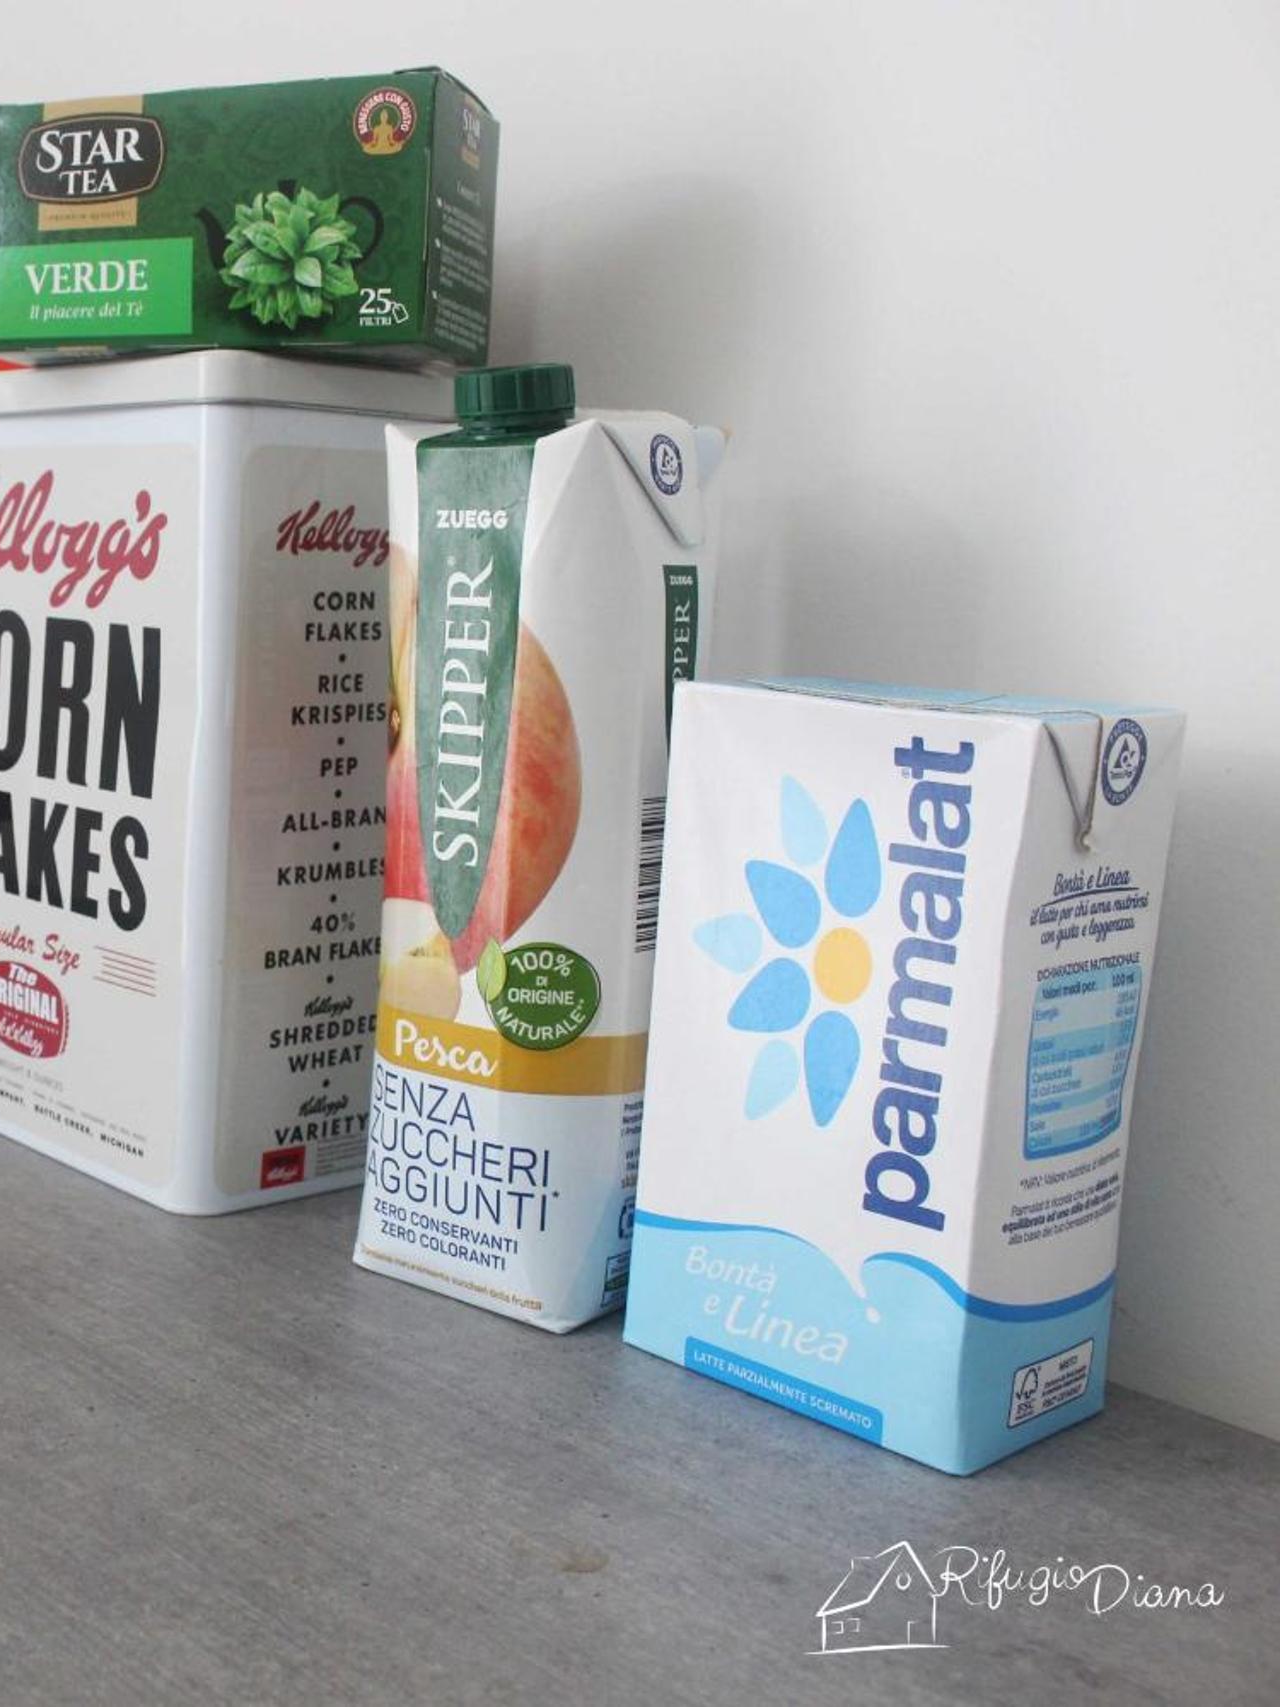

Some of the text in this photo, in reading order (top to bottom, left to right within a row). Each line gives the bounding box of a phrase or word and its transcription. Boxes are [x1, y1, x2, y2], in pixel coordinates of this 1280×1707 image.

[36, 127, 143, 173] STAR
[59, 169, 117, 195] TEA
[25, 259, 149, 295] VERDE
[30, 300, 143, 322] Il piacere del Tè
[359, 288, 392, 315] 25
[359, 316, 391, 326] FILTRI
[436, 508, 510, 530] ZUEGG
[276, 500, 390, 569] Kellogg
[313, 591, 376, 612] CORN
[305, 622, 382, 642] FLAKES
[672, 600, 690, 683] PPER
[319, 674, 364, 694] RICE
[292, 702, 387, 726] KRISPIES
[432, 556, 494, 867] SKIPPER
[320, 757, 359, 778] PEP
[281, 806, 387, 834] ALL-BRAN
[1096, 866, 1130, 888] Linea
[310, 911, 356, 934] 40%
[42, 934, 81, 976] Size
[264, 937, 382, 970] BRAN FLAKE
[511, 951, 574, 977] 100%
[9, 963, 38, 986] The
[535, 976, 548, 987] DI
[862, 736, 976, 1232] parmalat
[507, 987, 575, 1005] ORIGINE
[288, 1045, 363, 1074] WHEAT
[394, 1019, 499, 1078] Pesca
[375, 1063, 475, 1131] SENZA
[274, 1111, 369, 1146] VARIETY
[370, 1105, 550, 1188] ZUCCHERI
[374, 1197, 407, 1222] ZERO
[410, 1211, 518, 1254] CONSERVANTI
[380, 1219, 415, 1244] ZERO
[419, 1234, 506, 1271] COLORANTI
[685, 1246, 778, 1294] Bontà
[704, 1294, 849, 1364] e Linea
[694, 1350, 873, 1429] LATTE PARZIALMENTE SCREMATO
